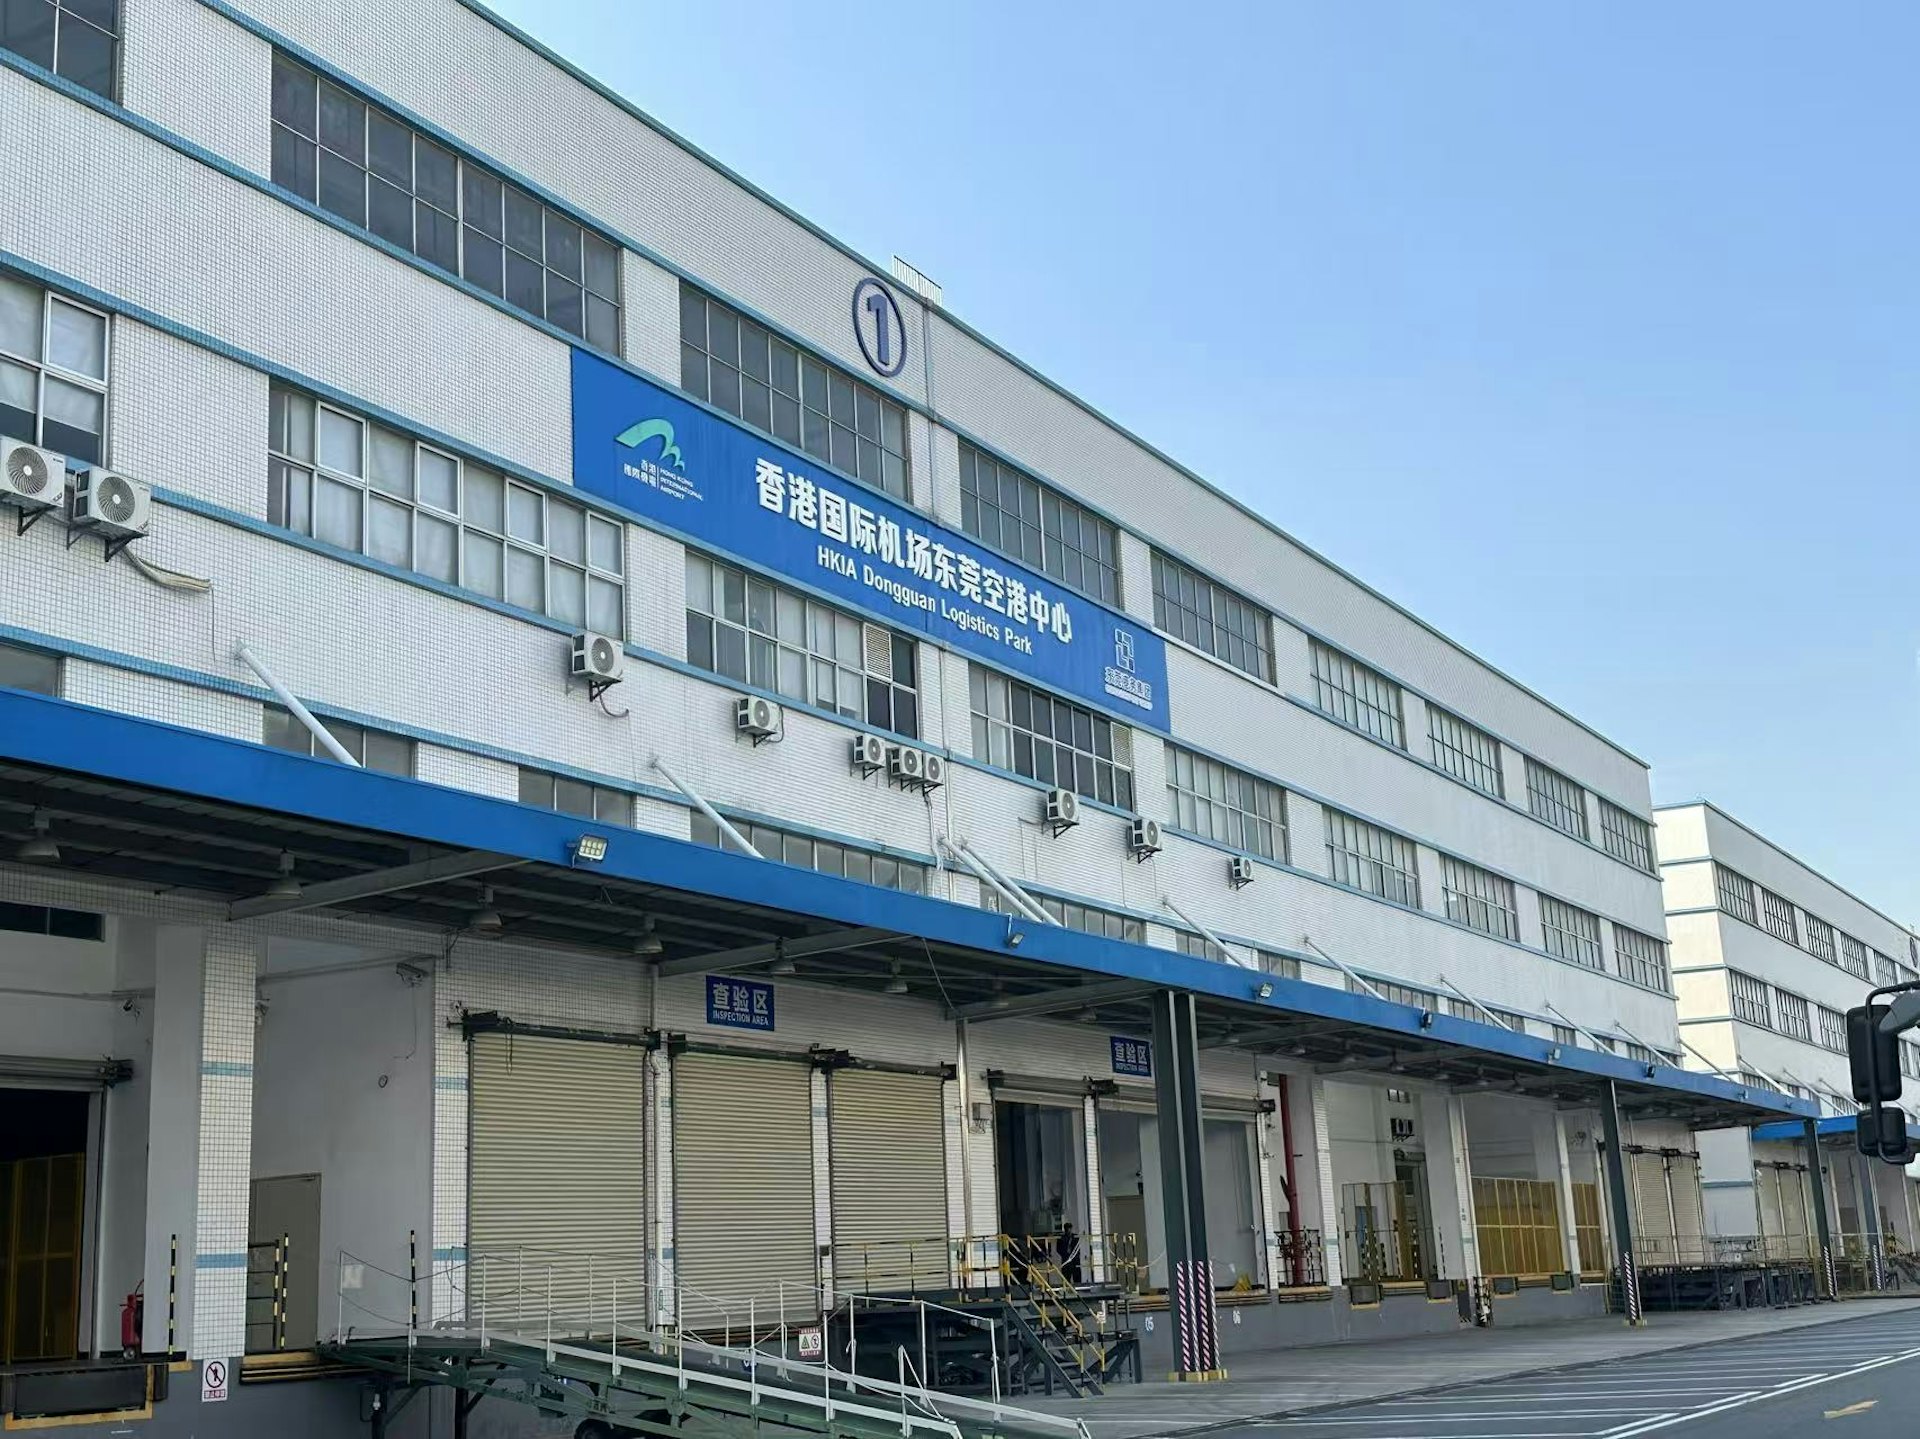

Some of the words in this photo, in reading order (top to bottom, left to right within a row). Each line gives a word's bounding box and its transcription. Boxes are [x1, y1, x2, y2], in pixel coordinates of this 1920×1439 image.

[755, 457, 1073, 644] 香港国际机场东莞空港中心
[817, 545, 858, 580] HKIA
[863, 564, 936, 613] Dongguan
[941, 599, 1000, 641] Logistics
[1005, 626, 1033, 655] Park
[713, 983, 768, 1014] 查验区
[713, 1011, 750, 1023] INSPECTION
[752, 1016, 768, 1025] AREA
